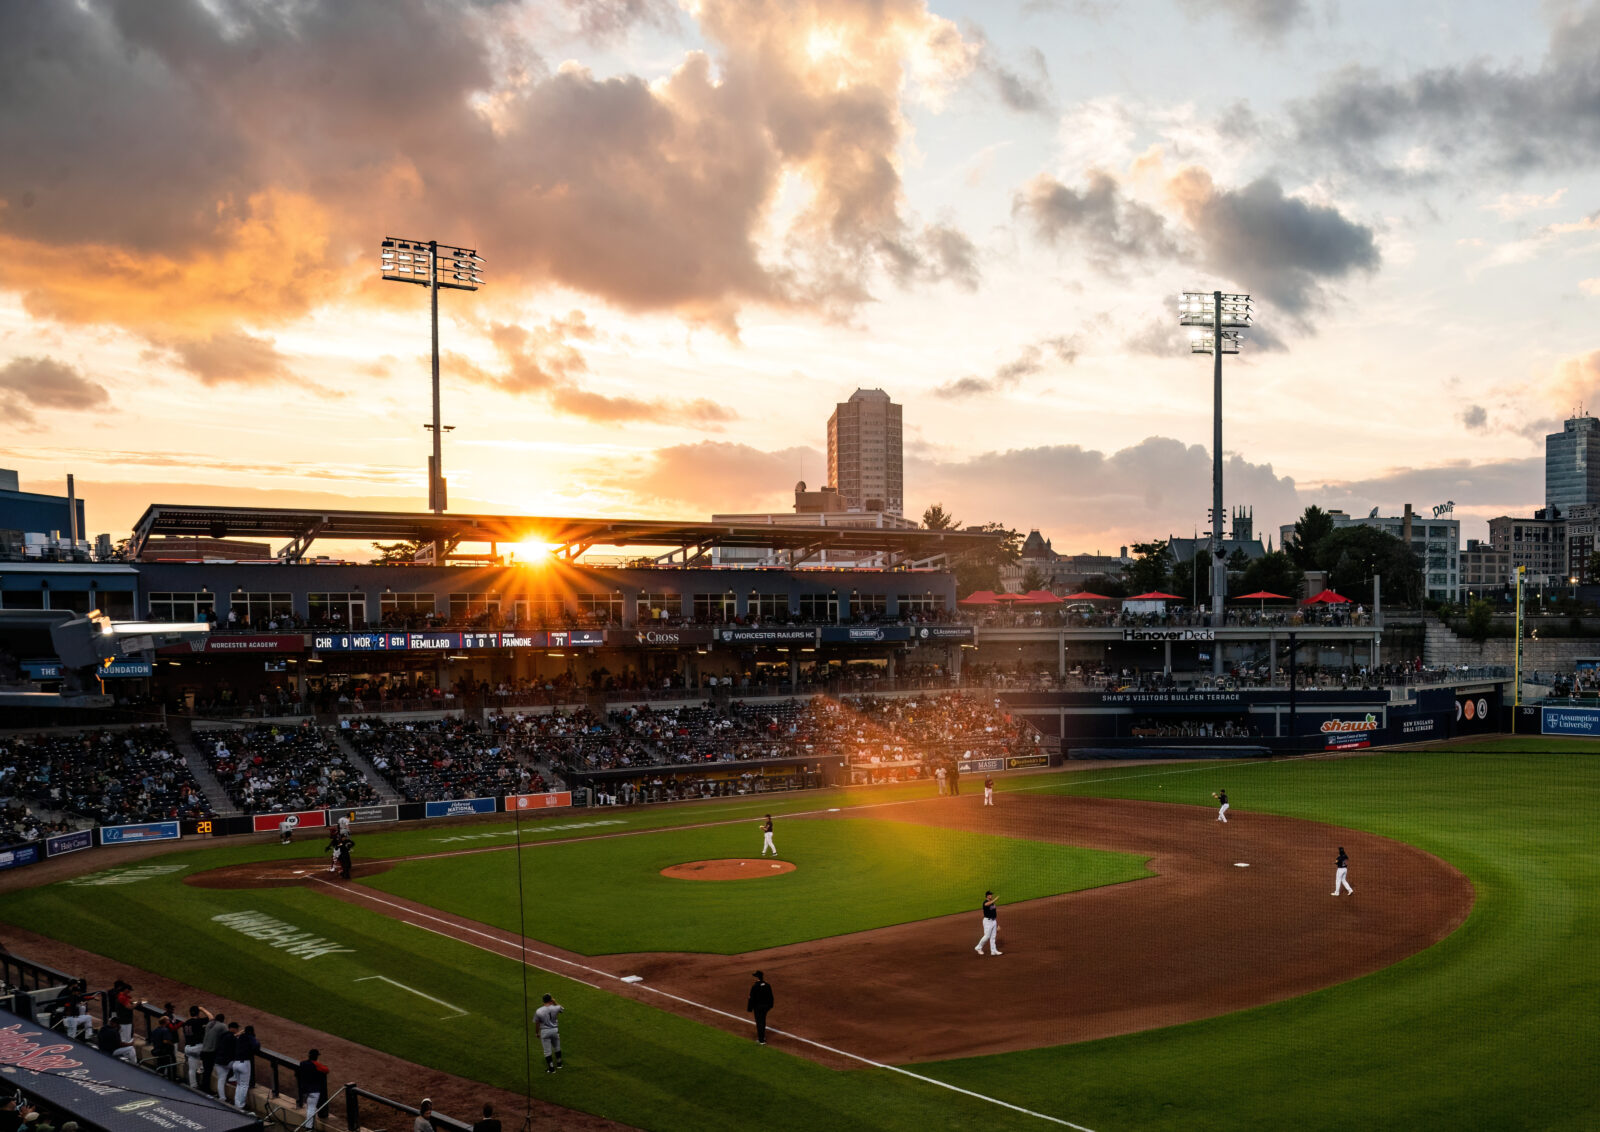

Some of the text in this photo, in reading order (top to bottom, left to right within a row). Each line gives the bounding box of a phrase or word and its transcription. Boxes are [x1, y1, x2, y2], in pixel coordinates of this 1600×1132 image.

[734, 632, 776, 640] WORCESTER
[210, 640, 279, 649] WORCESTER ACADEMY
[315, 638, 332, 648] CHR
[342, 638, 348, 648] 0
[353, 637, 371, 647] WOR
[379, 638, 385, 647] 2
[391, 637, 405, 646] 6TH
[411, 639, 450, 649] REMILLARD
[466, 639, 471, 648] 0
[479, 638, 484, 647] 0
[502, 638, 532, 647] PANNONE
[555, 638, 564, 646] 71
[41, 665, 149, 676] THE FOUNDATION
[1207, 693, 1240, 701] TERRACE
[1559, 714, 1599, 723] Assumption
[1559, 721, 1593, 730] University
[447, 805, 475, 813] NATIONAL
[198, 821, 212, 834] 28
